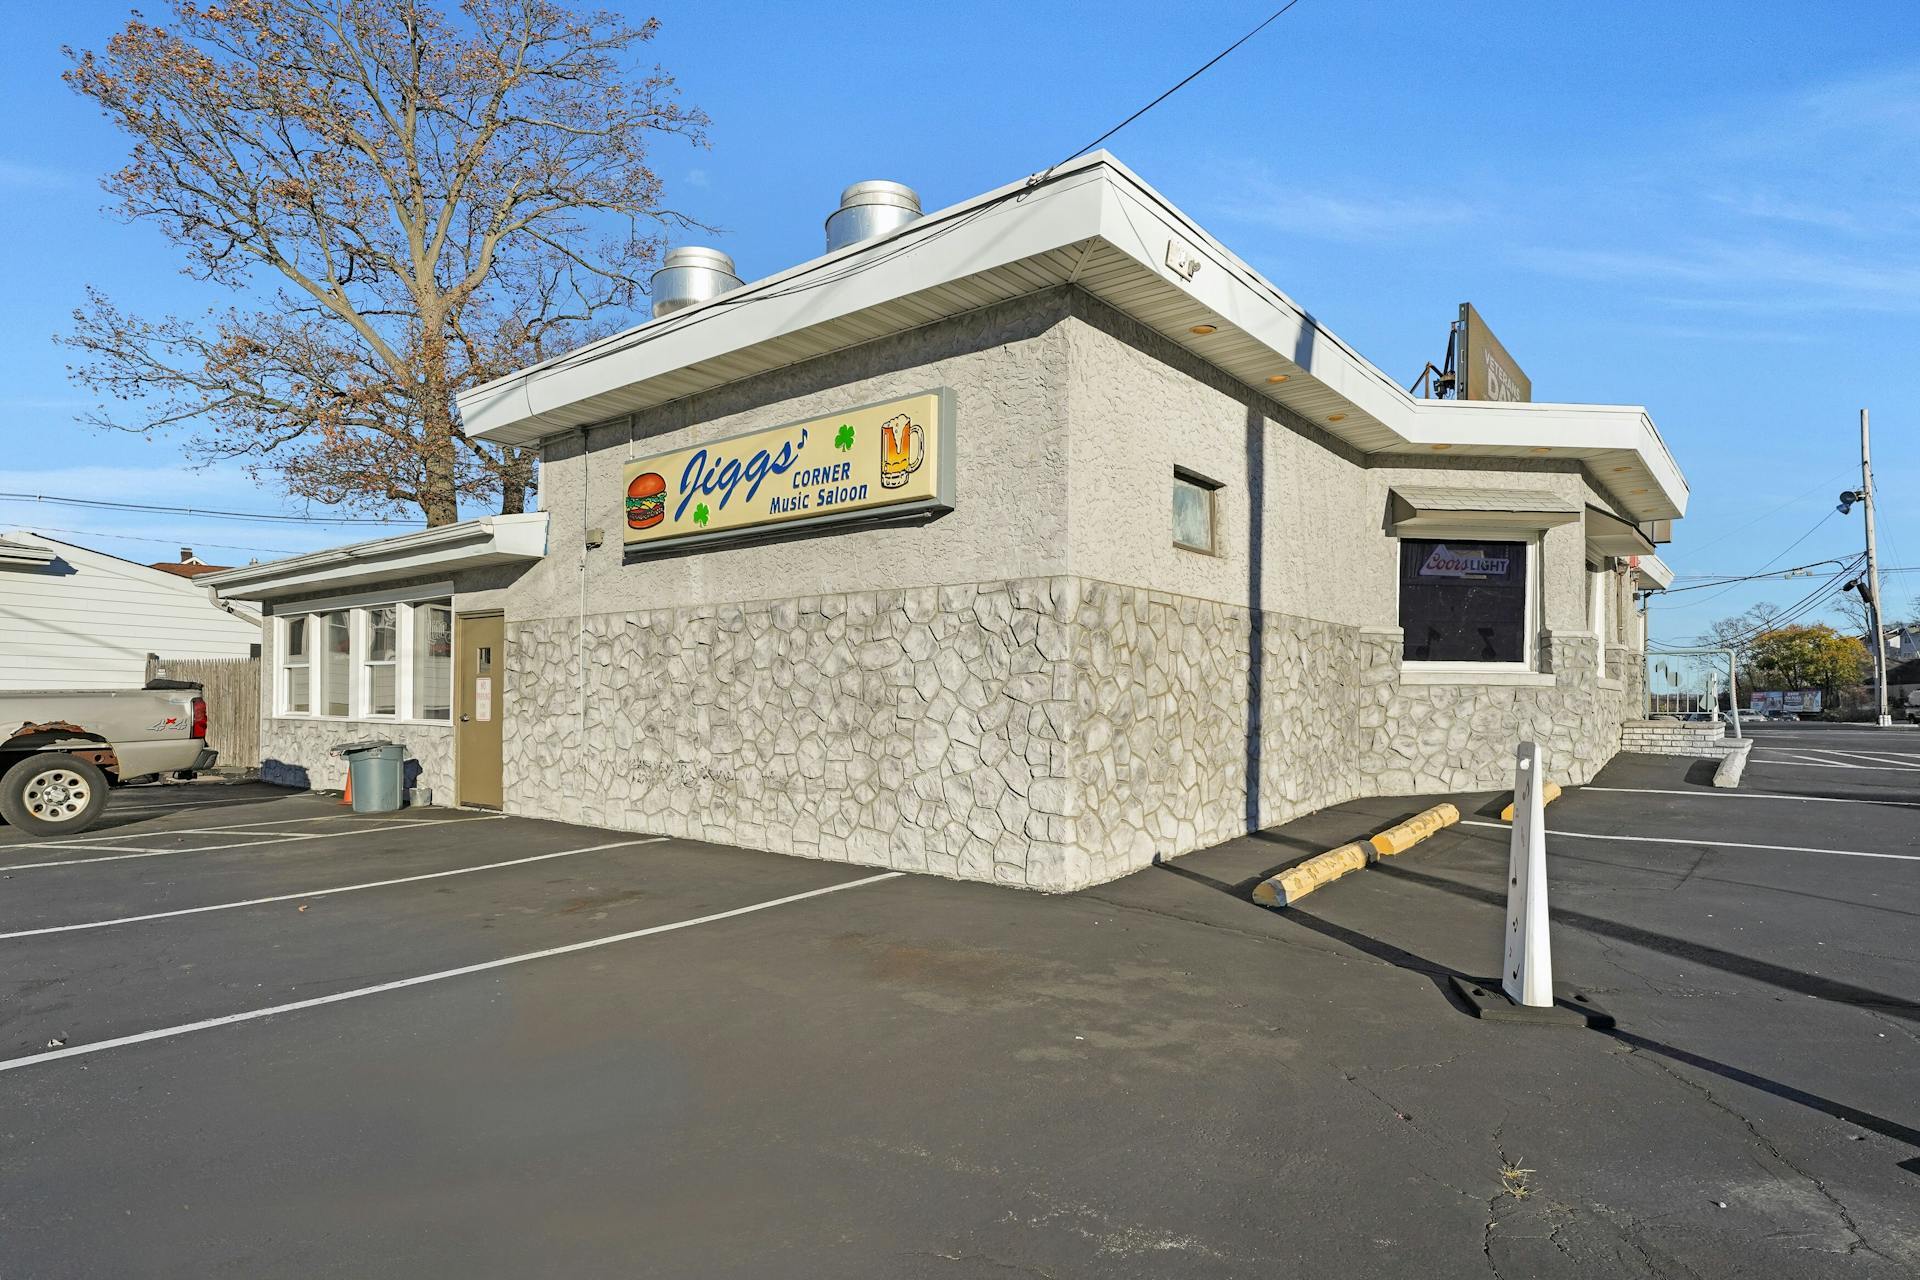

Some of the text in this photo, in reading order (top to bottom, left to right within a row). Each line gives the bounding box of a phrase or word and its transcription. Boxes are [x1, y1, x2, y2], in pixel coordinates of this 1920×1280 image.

[1484, 348, 1520, 400] VETERANS
[792, 462, 851, 489] CORNER
[769, 484, 868, 515] Music Saloon
[1426, 553, 1507, 572] Coors LIGHT
